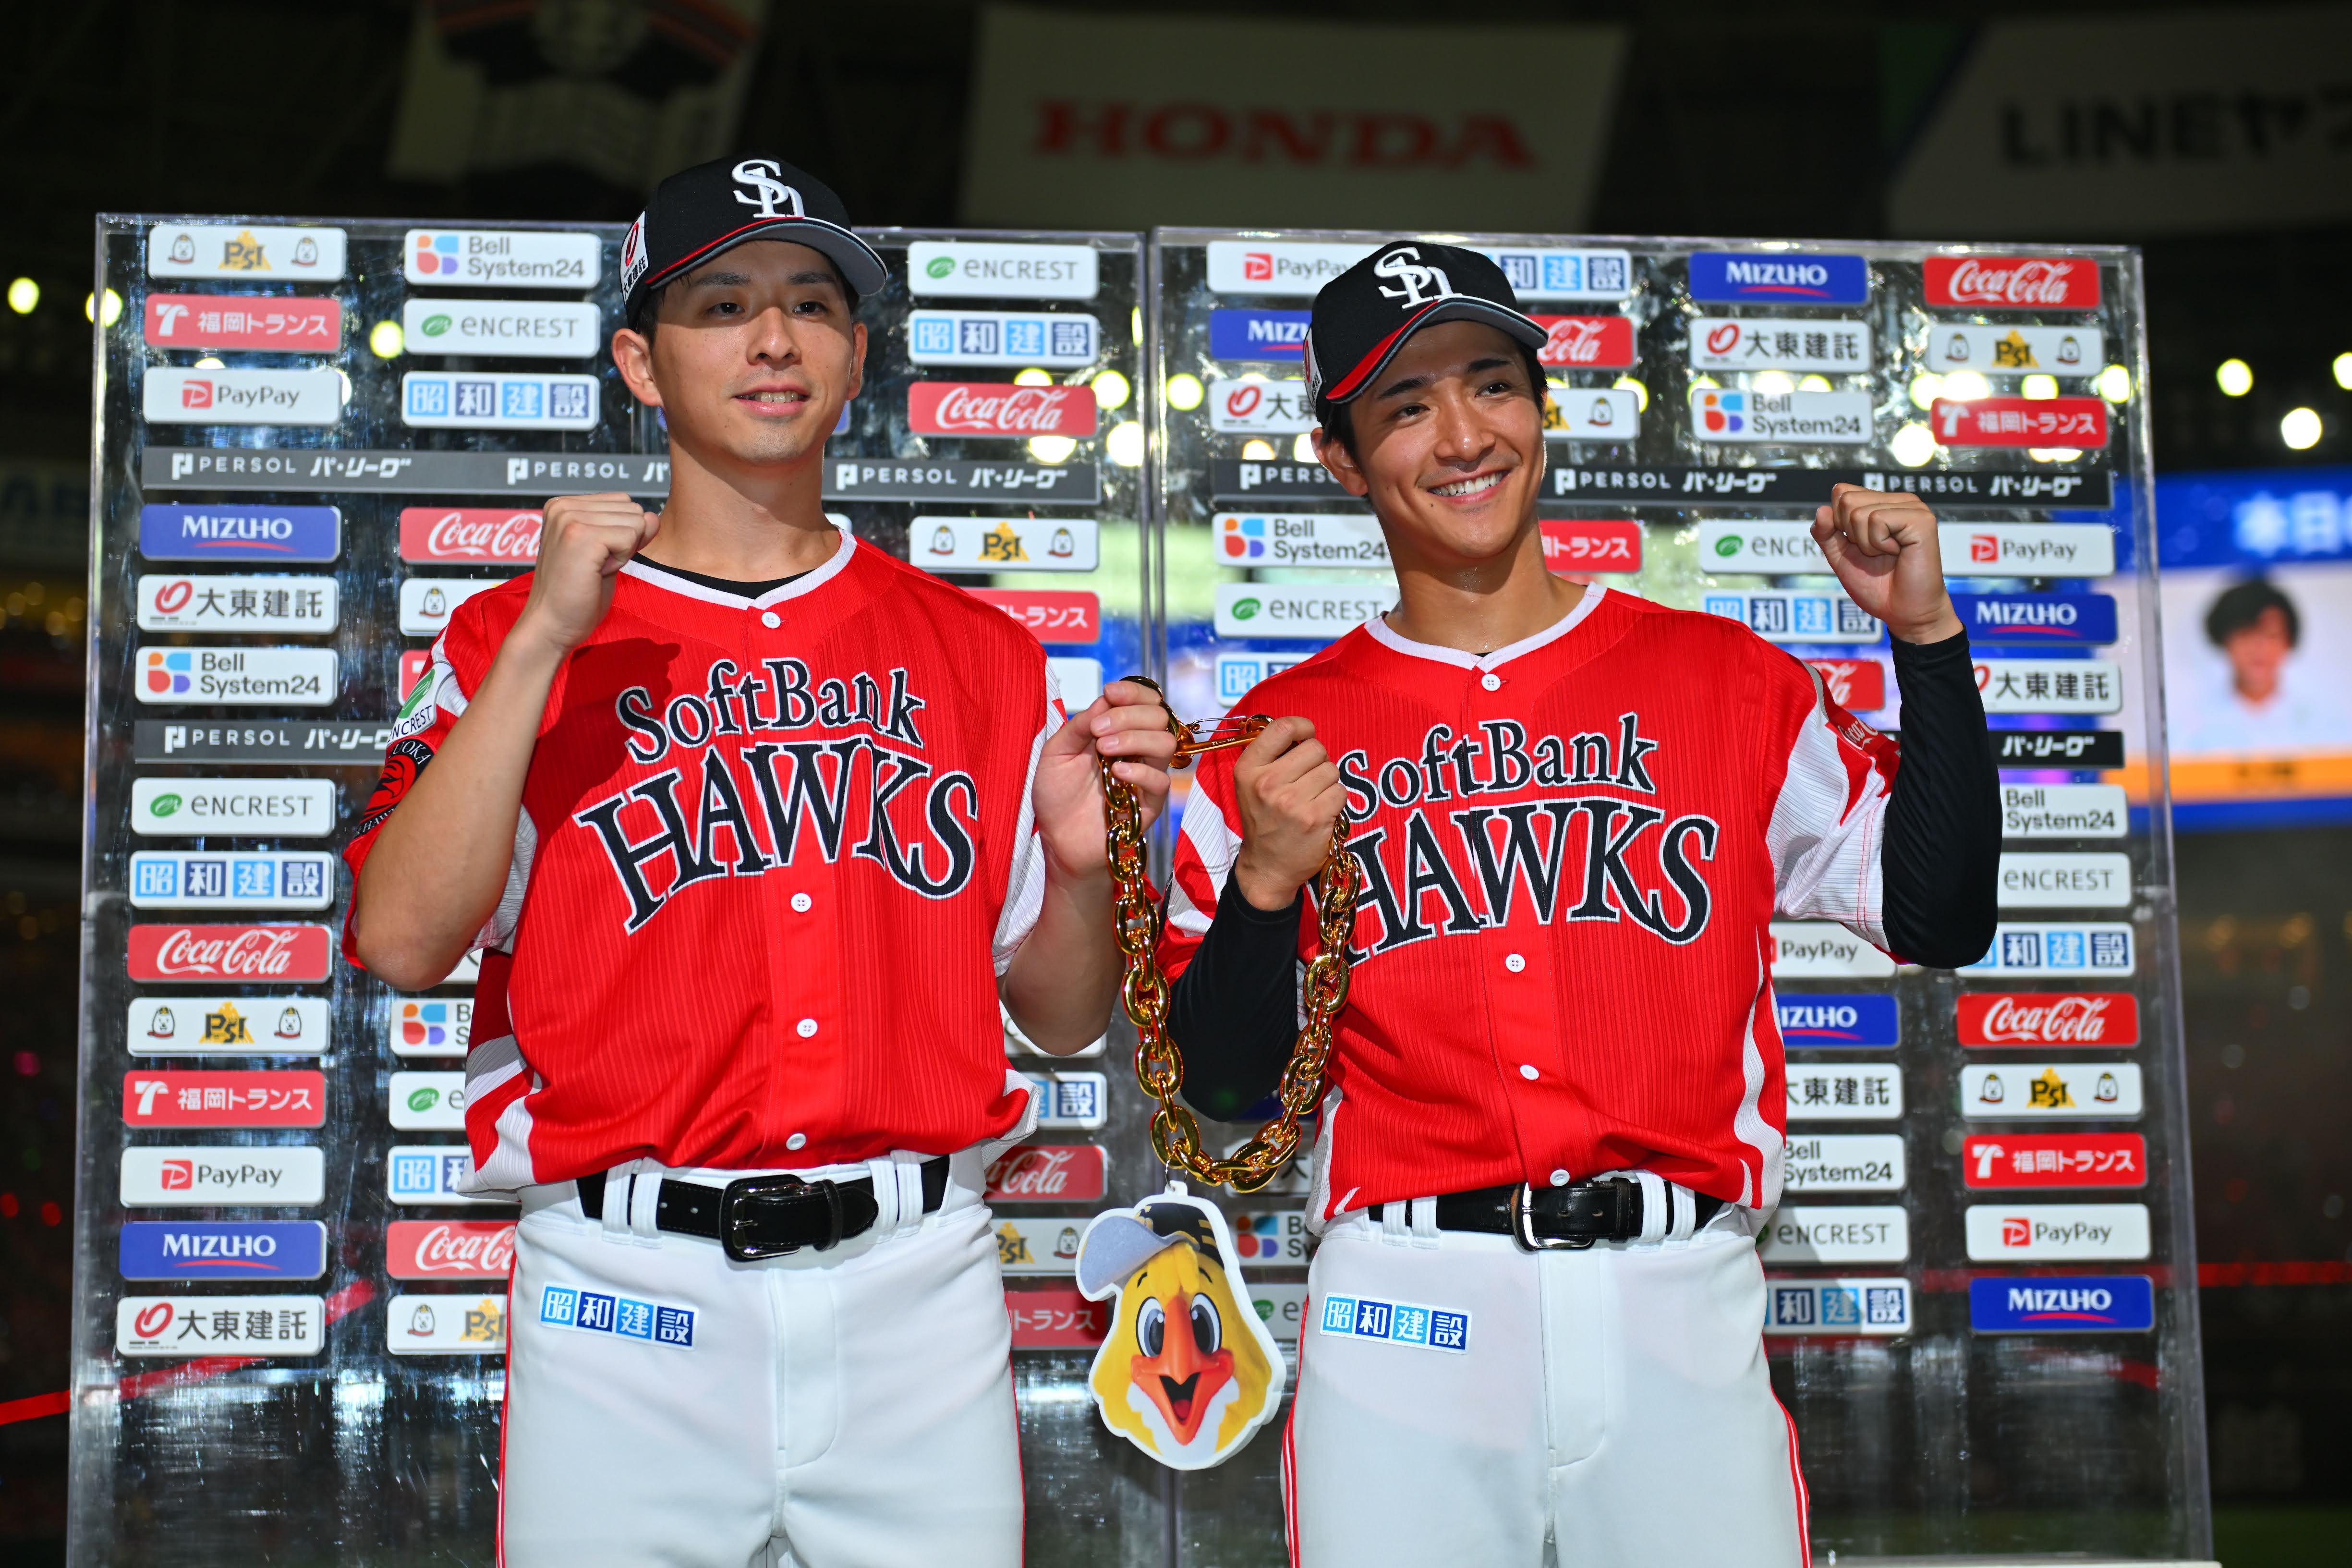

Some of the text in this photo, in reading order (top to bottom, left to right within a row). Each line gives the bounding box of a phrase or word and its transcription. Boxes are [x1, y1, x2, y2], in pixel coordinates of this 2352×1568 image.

[1035, 100, 1537, 170] HONDA
[469, 236, 510, 255] Bell
[468, 258, 584, 281] System24
[1502, 256, 1623, 290] 和建設
[1726, 262, 1828, 285] MIZUHO
[1949, 261, 2074, 303] Coca-Cola
[197, 312, 328, 335] 福岡トランス
[1248, 320, 1310, 341] MIZ
[917, 322, 1087, 355] 昭和建設
[1745, 332, 1858, 360] 大東建託
[218, 386, 300, 408] PayPay
[411, 383, 588, 417] 昭和建設
[936, 387, 1068, 430] Coca-Cola
[1753, 395, 1790, 412] Bell
[1752, 417, 1862, 437] System24
[1978, 412, 2097, 434] 福岡トランス
[200, 457, 411, 477] PERSOL パ・リーグ
[534, 462, 629, 477] PERSOL
[863, 467, 1067, 489] PERSOL パ・リーグ
[1266, 469, 1337, 483] PERS
[1580, 474, 1776, 492] PERSOL パ・リーグ
[1889, 476, 2082, 497] PERSOL パ・リーグ
[182, 516, 292, 539] MIZUHO
[428, 512, 543, 556] Coca-Col
[1274, 519, 1315, 537] Bell
[1274, 541, 1386, 562] System24
[1543, 537, 1630, 558] トランス
[2003, 539, 2077, 559] PayPay
[196, 589, 322, 619] 大東建託
[1977, 602, 2077, 624] MIZUHO
[999, 607, 1088, 628] トランス
[201, 653, 244, 671] Bell
[200, 676, 321, 699] System24
[1996, 671, 2109, 700] 大東建託
[615, 657, 926, 765] SoftBank
[387, 705, 432, 743] NCREST
[193, 730, 289, 745] PERSOL
[2002, 736, 2094, 756] パ・リーグ
[1337, 711, 1659, 824] SoftBank
[2006, 789, 2045, 807] Bell
[2007, 813, 2115, 833] System24
[572, 734, 979, 936] HAWKS
[139, 863, 321, 896] 昭和建設
[1305, 796, 1720, 968] HAWKS
[157, 929, 299, 975] Coca-Cola
[1782, 941, 1858, 963] PayPay
[2006, 933, 2128, 967] 和建設
[1782, 1006, 1857, 1027] IZUHO
[1983, 997, 2110, 1041] Coca-Cola
[178, 1088, 312, 1111] 福岡トランス
[1786, 1141, 1820, 1160] Bell
[2013, 1150, 2134, 1173] 福岡トランス
[197, 1166, 282, 1188] PayPay
[1785, 1163, 1892, 1187] System24
[163, 1234, 276, 1257] MIZUHO
[2036, 1224, 2113, 1244] PayPay
[416, 1226, 515, 1271] Coca-C
[1780, 1289, 1903, 1323] 和建設
[2008, 1288, 2111, 1311] MIZUHO
[177, 1310, 306, 1341] 大東建託
[544, 1289, 690, 1343] 昭和建設
[1012, 1309, 1096, 1331] トランス
[1327, 1301, 1463, 1347] 昭和建設
